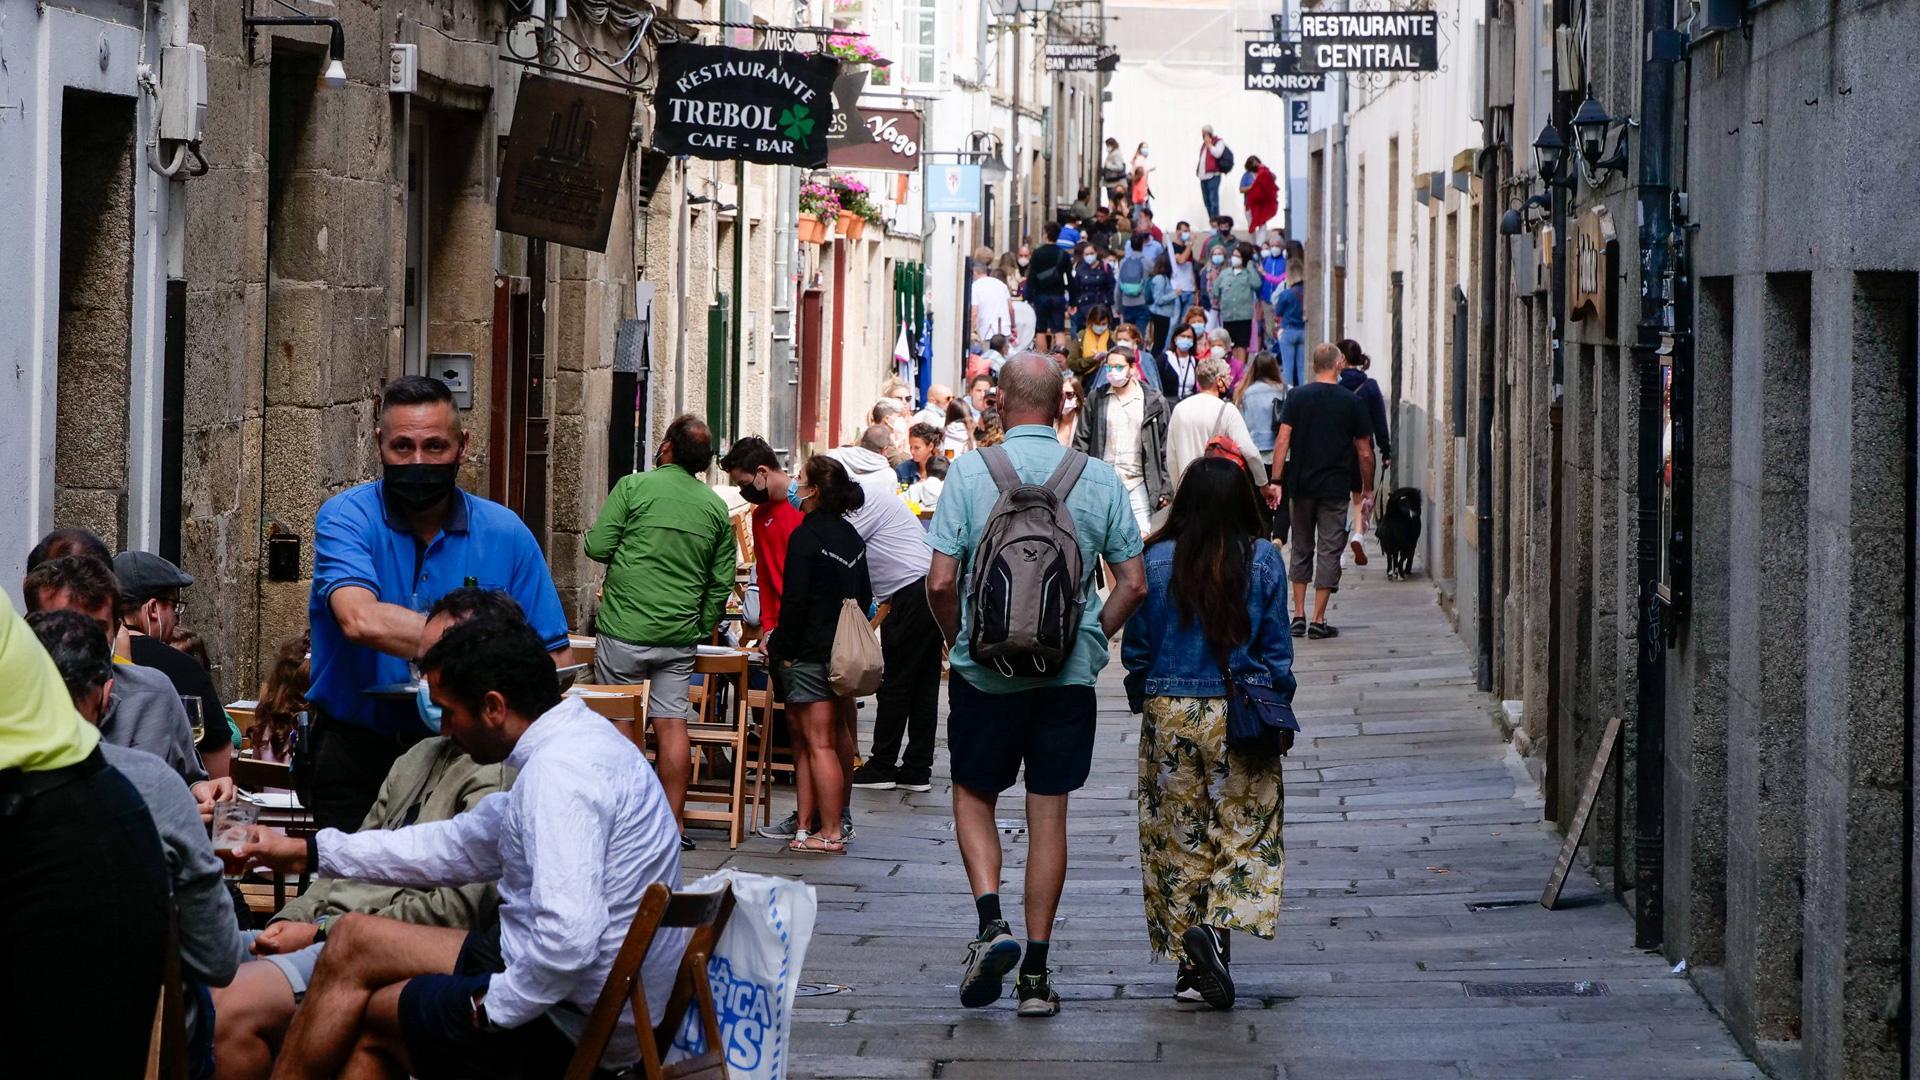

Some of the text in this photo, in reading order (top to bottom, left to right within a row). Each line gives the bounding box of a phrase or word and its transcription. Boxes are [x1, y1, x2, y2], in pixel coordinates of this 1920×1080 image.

[1303, 15, 1434, 37] RESTAURANTE
[1248, 43, 1282, 58] Café
[1317, 44, 1420, 68] CENTRAL
[1046, 57, 1098, 70] SAN JAIME
[676, 61, 816, 104] RESTAURANTE
[1248, 74, 1321, 89] MONROY
[669, 98, 778, 131] TREBOL
[687, 132, 737, 149] CAFE
[756, 138, 795, 154] BAR
